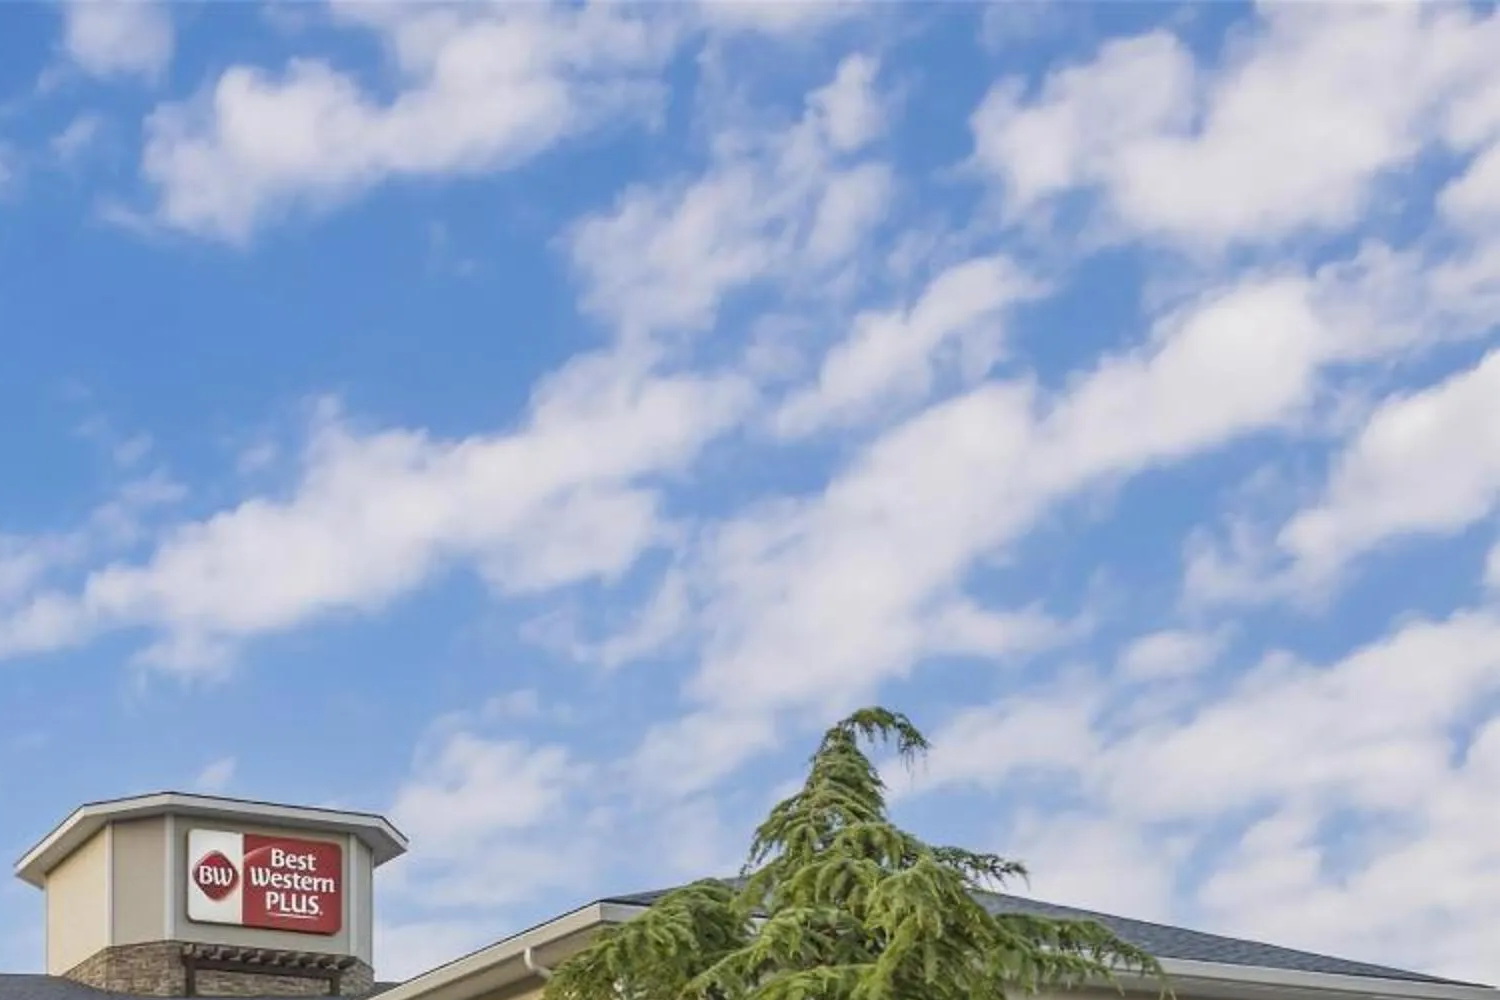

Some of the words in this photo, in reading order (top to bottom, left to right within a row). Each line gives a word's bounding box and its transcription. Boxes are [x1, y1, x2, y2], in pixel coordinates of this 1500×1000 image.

[271, 848, 316, 871] Best
[200, 866, 232, 886] BW
[251, 867, 335, 893] Western
[266, 891, 319, 915] PLUS
